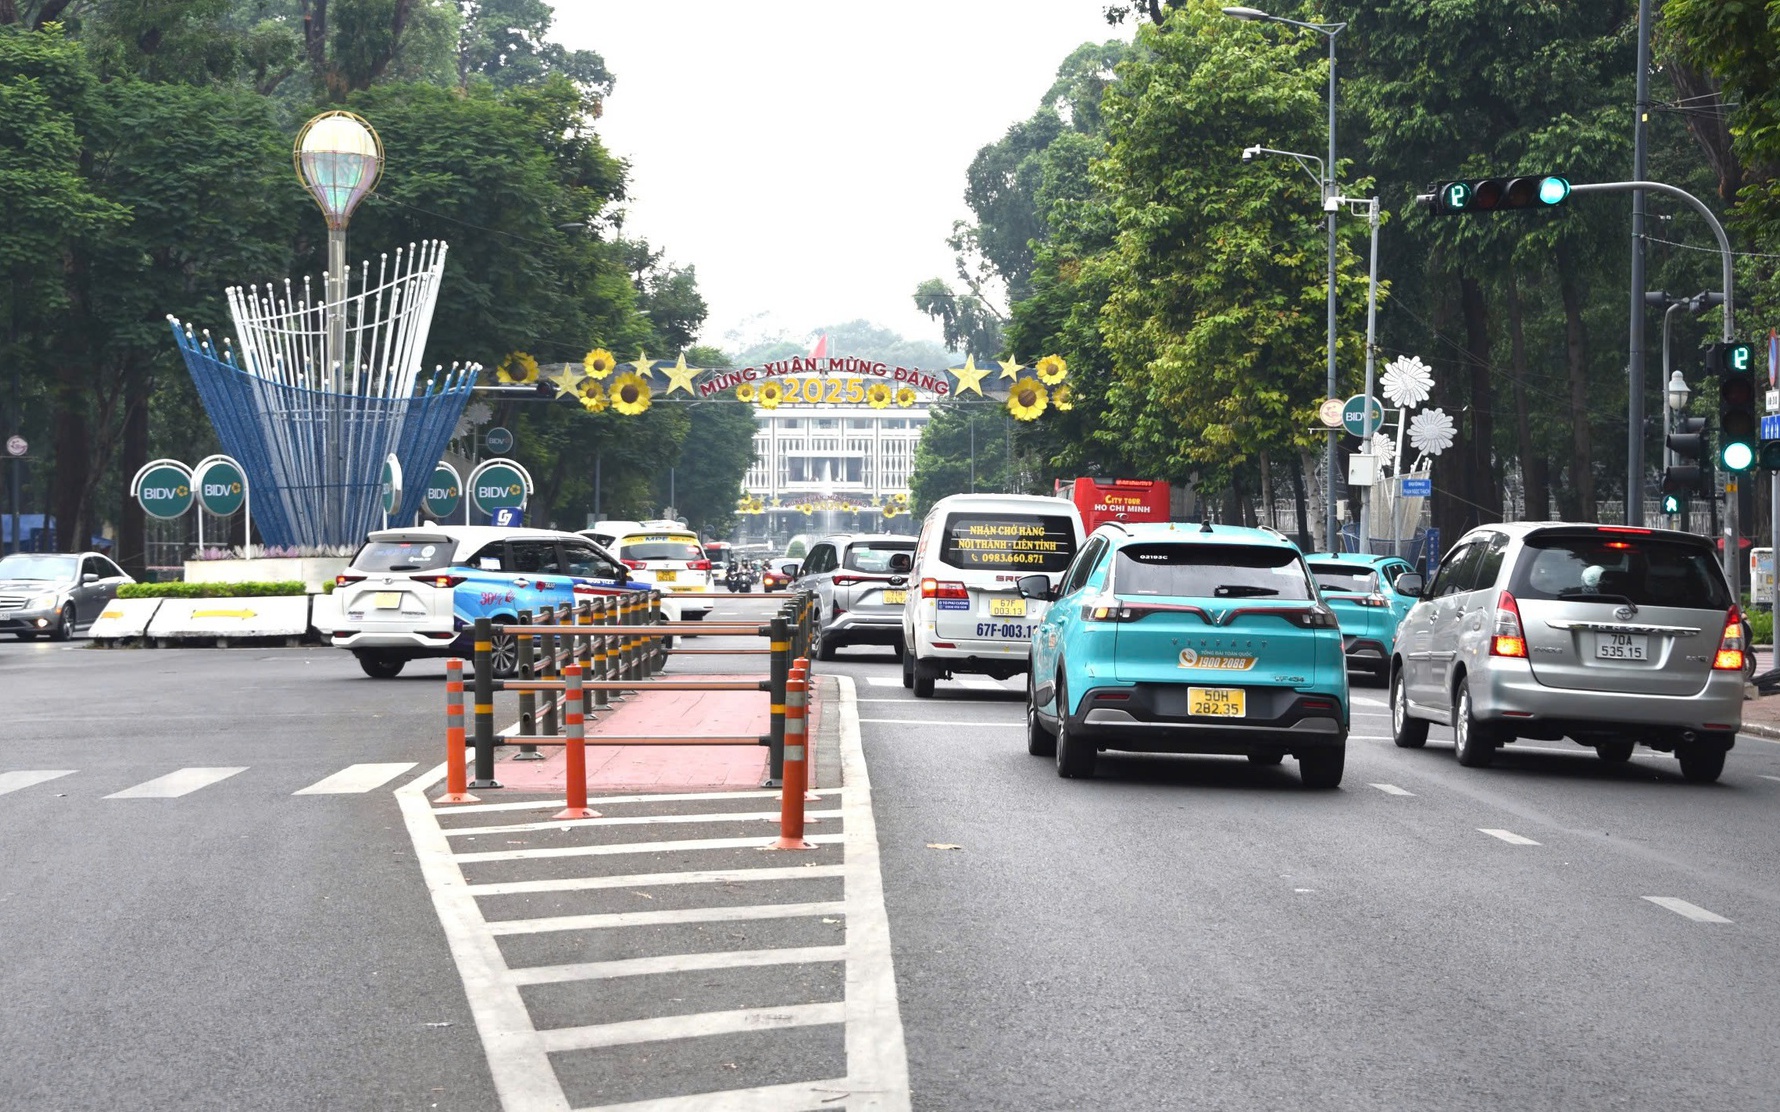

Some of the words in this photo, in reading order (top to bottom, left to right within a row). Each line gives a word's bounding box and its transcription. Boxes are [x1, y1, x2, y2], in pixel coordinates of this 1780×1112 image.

[1451, 185, 1464, 207] 12
[1734, 347, 1748, 370] 12
[700, 367, 757, 397] MỪNG
[764, 356, 824, 377] XUÂN,
[829, 356, 887, 376] MỪNG
[894, 367, 949, 395] ĐẢNG
[782, 377, 865, 404] 2025
[488, 437, 505, 445] BIDV
[144, 487, 176, 500] BIDV
[204, 484, 231, 496] BIDV
[428, 488, 450, 500] BIDV
[479, 486, 510, 498] BIDV
[1127, 505, 1151, 513] MINH
[969, 524, 997, 538] NHẬN
[1019, 525, 1045, 537] HÀNG
[975, 538, 1007, 549] THÀNH
[1012, 539, 1033, 550] LIÊN
[982, 553, 1044, 564] 0983.660.871
[994, 607, 1023, 615] 003.13
[1610, 634, 1633, 646] 70A
[1601, 646, 1642, 658] 535.15
[1198, 656, 1221, 668] 1900
[1221, 658, 1246, 669] 2088
[1204, 690, 1229, 702] 50H
[1195, 702, 1239, 714] 282.35
